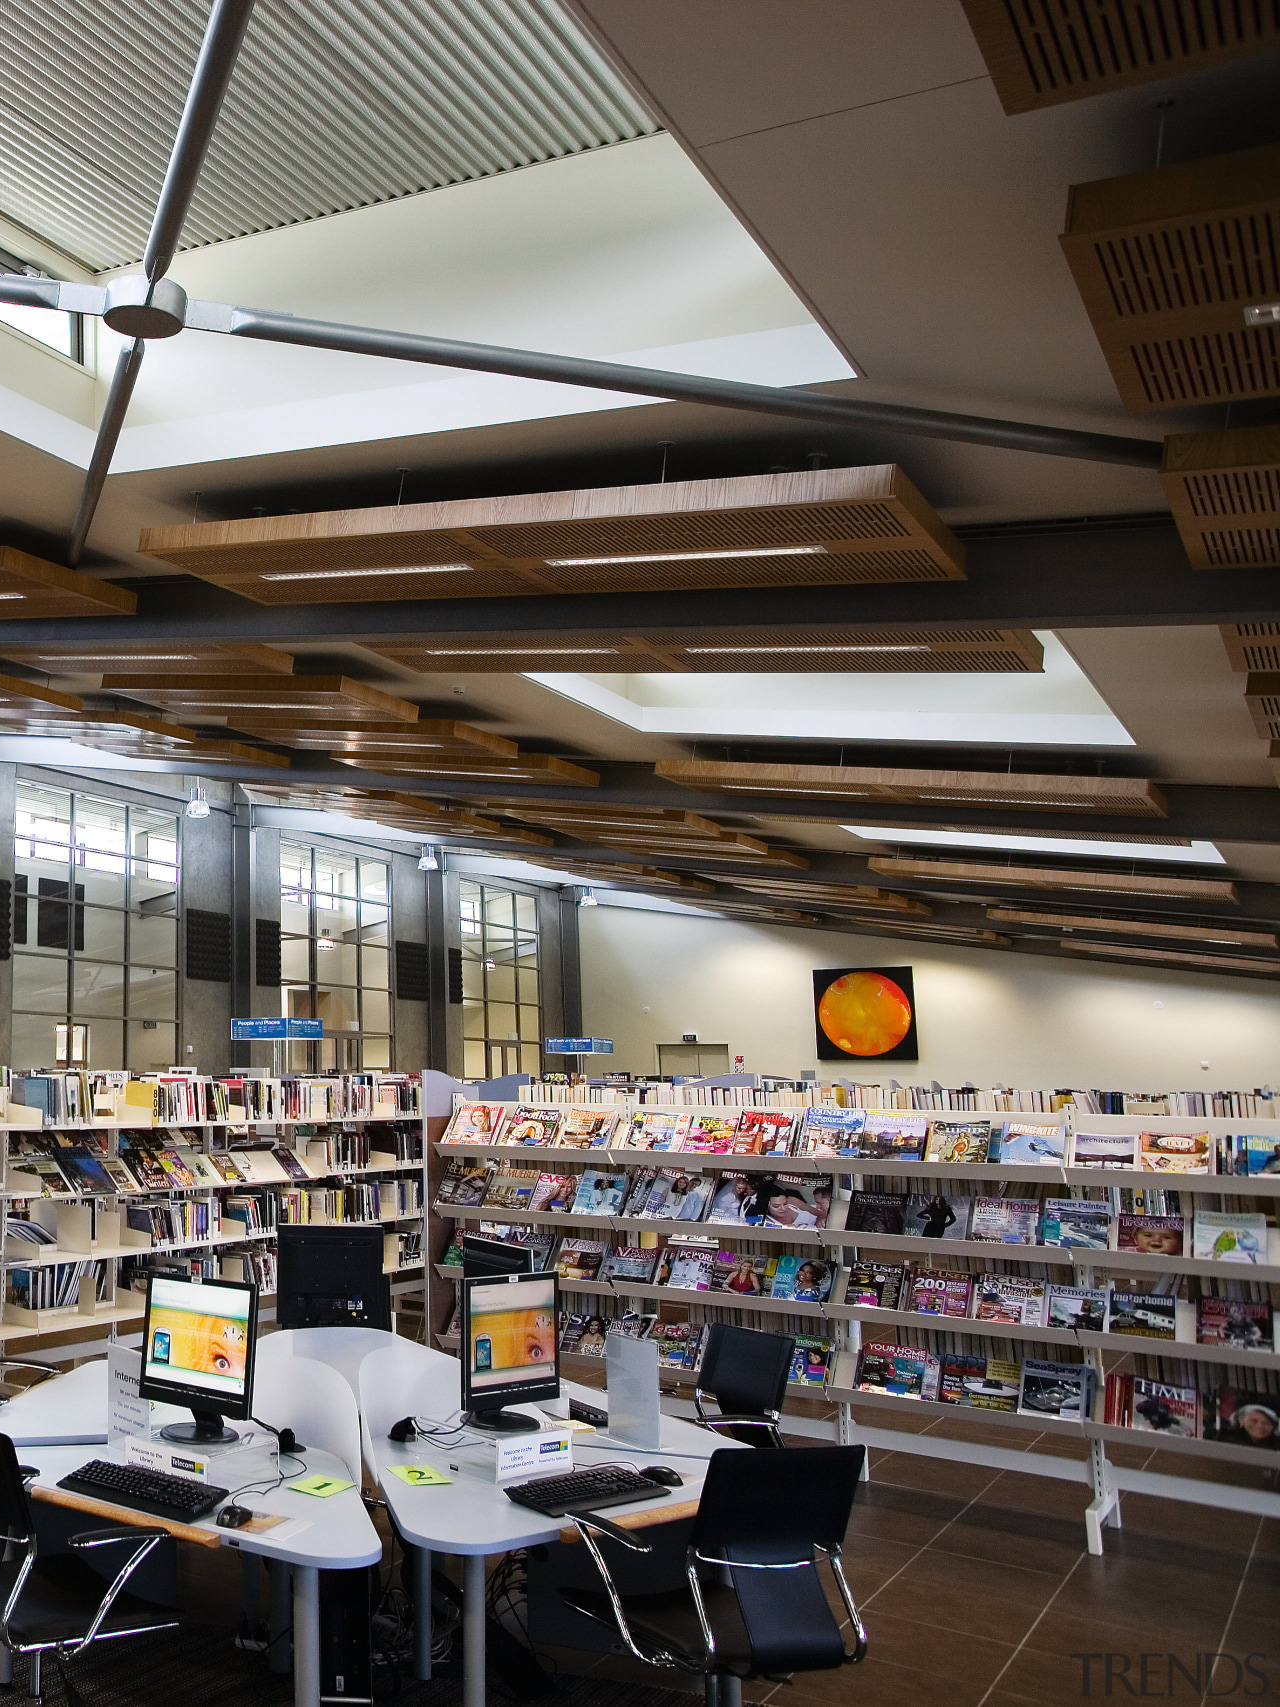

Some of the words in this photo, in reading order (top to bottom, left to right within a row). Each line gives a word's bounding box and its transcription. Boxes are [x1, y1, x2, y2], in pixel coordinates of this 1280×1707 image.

[809, 1108, 846, 1117] COUNTRY
[868, 1115, 907, 1123] COUNTRY
[1080, 1137, 1130, 1145] architecture
[449, 1163, 460, 1173] EL
[460, 1166, 491, 1177] MUEBLE
[496, 1167, 506, 1176] EL
[508, 1169, 540, 1179] MUEBLE
[661, 1167, 685, 1179] HELLO!
[540, 1173, 566, 1184] eve
[722, 1171, 748, 1180] HELLO!
[777, 1174, 802, 1184] HELLO!
[854, 1197, 904, 1205] PHOTOGRAPHY
[976, 1198, 1003, 1209] Ideal
[1006, 1201, 1039, 1212] home
[1047, 1200, 1076, 1208] Leisure
[1078, 1202, 1107, 1210] Painter
[1198, 1213, 1228, 1221] Leisure
[1122, 1217, 1184, 1230] Treasures
[514, 1231, 529, 1242] NZ
[564, 1239, 579, 1249] NZ
[616, 1246, 631, 1257] NZ
[692, 1252, 714, 1261] WORL
[853, 1262, 867, 1270] PC
[871, 1265, 902, 1274] USER
[917, 1268, 938, 1277] PC
[939, 1270, 969, 1280] USER
[915, 1277, 946, 1291] 200
[986, 1274, 1006, 1283] PC
[1007, 1276, 1041, 1288] USER
[998, 1289, 1032, 1299] Invasion
[1001, 1284, 1031, 1294] Privacy
[1050, 1286, 1106, 1299] Memories
[1113, 1291, 1173, 1307] motorhome
[654, 1321, 690, 1336] aste
[795, 1338, 822, 1346] indows
[869, 1342, 895, 1353] YOUR
[896, 1347, 926, 1357] HOME
[898, 1353, 925, 1361] GARDEN
[1026, 1360, 1082, 1377] SeaSpray
[115, 1370, 140, 1387] Interne
[944, 1374, 960, 1382] Boeing
[1139, 1379, 1195, 1402] TIME
[118, 1414, 132, 1422] minimum
[133, 1420, 145, 1428] charge
[131, 1446, 149, 1456] Welcome
[503, 1448, 520, 1456] Welcome
[541, 1443, 559, 1451] Telecom
[140, 1456, 153, 1465] Library
[172, 1457, 194, 1470] Telecom
[501, 1463, 521, 1471] Information
[408, 1470, 432, 1480] 2
[312, 1482, 333, 1491] 1
